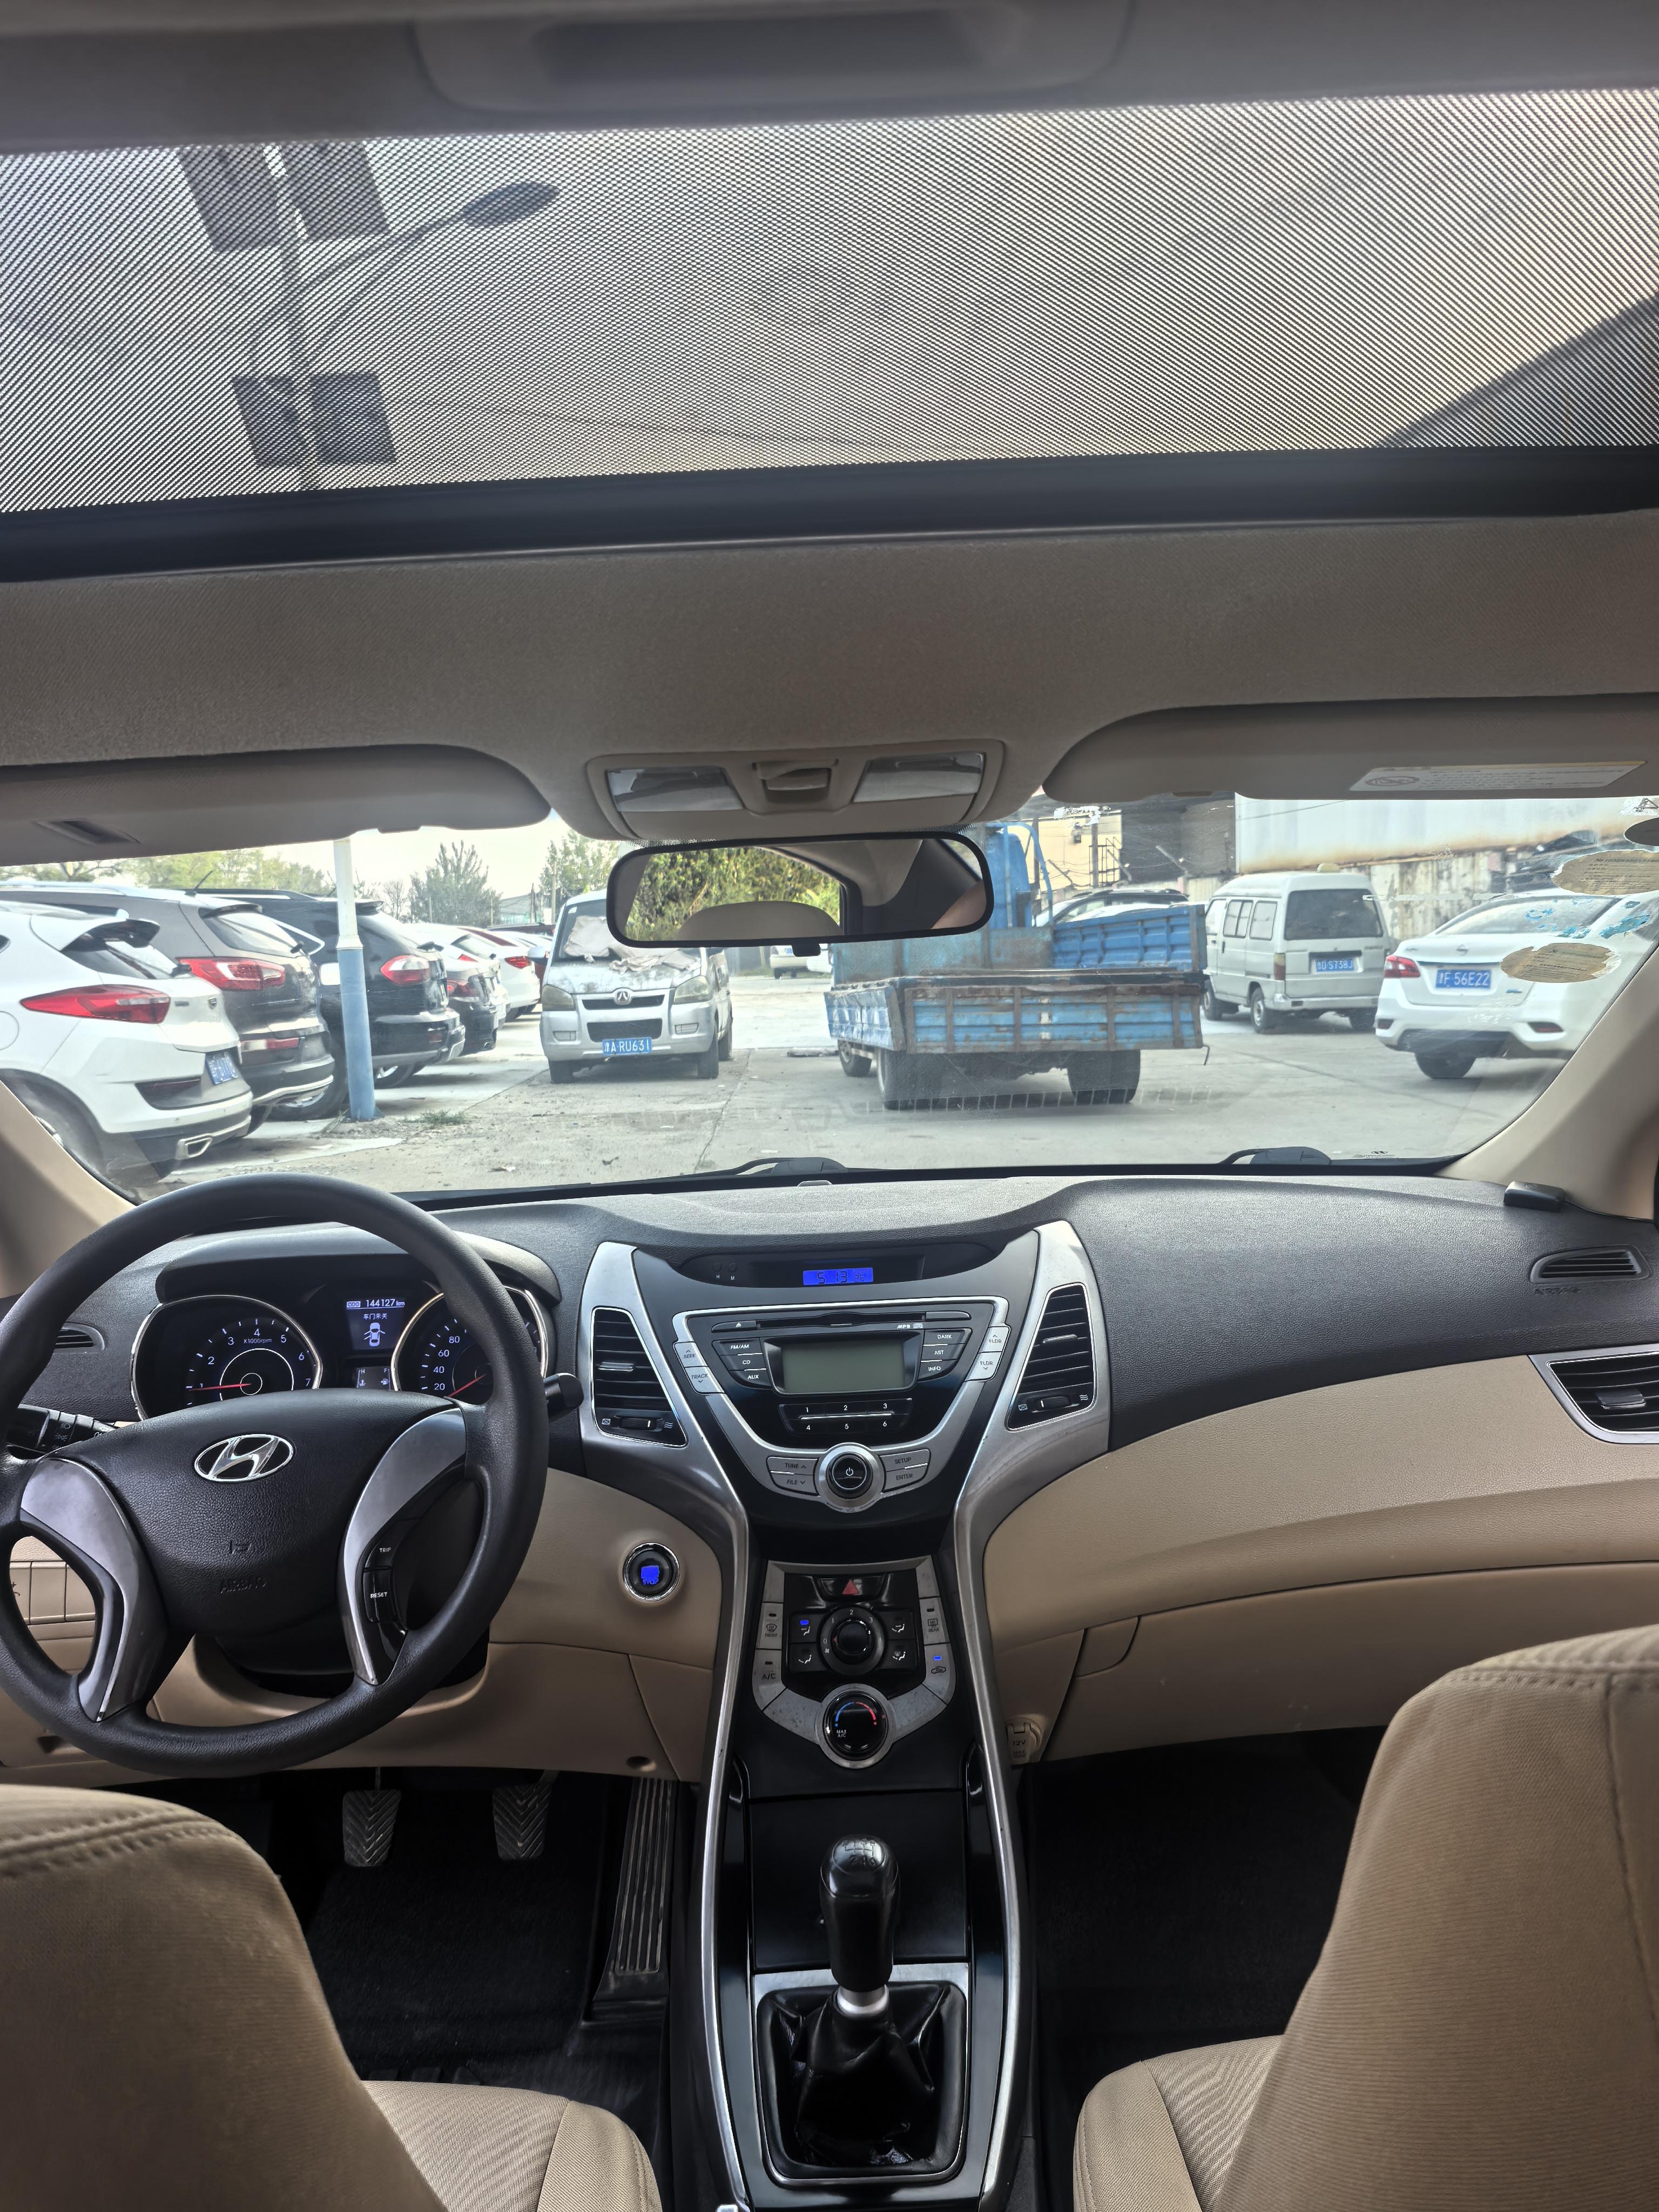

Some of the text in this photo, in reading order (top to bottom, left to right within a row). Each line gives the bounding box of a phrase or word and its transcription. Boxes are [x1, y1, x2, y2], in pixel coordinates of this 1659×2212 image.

[366, 1299, 395, 1307] 144127
[254, 1328, 260, 1337] 4
[228, 1337, 234, 1345] 3
[281, 1335, 287, 1343] 5
[449, 1336, 460, 1344] 80
[299, 1352, 305, 1360] 6
[208, 1356, 215, 1365] 2
[306, 1378, 311, 1387] 7
